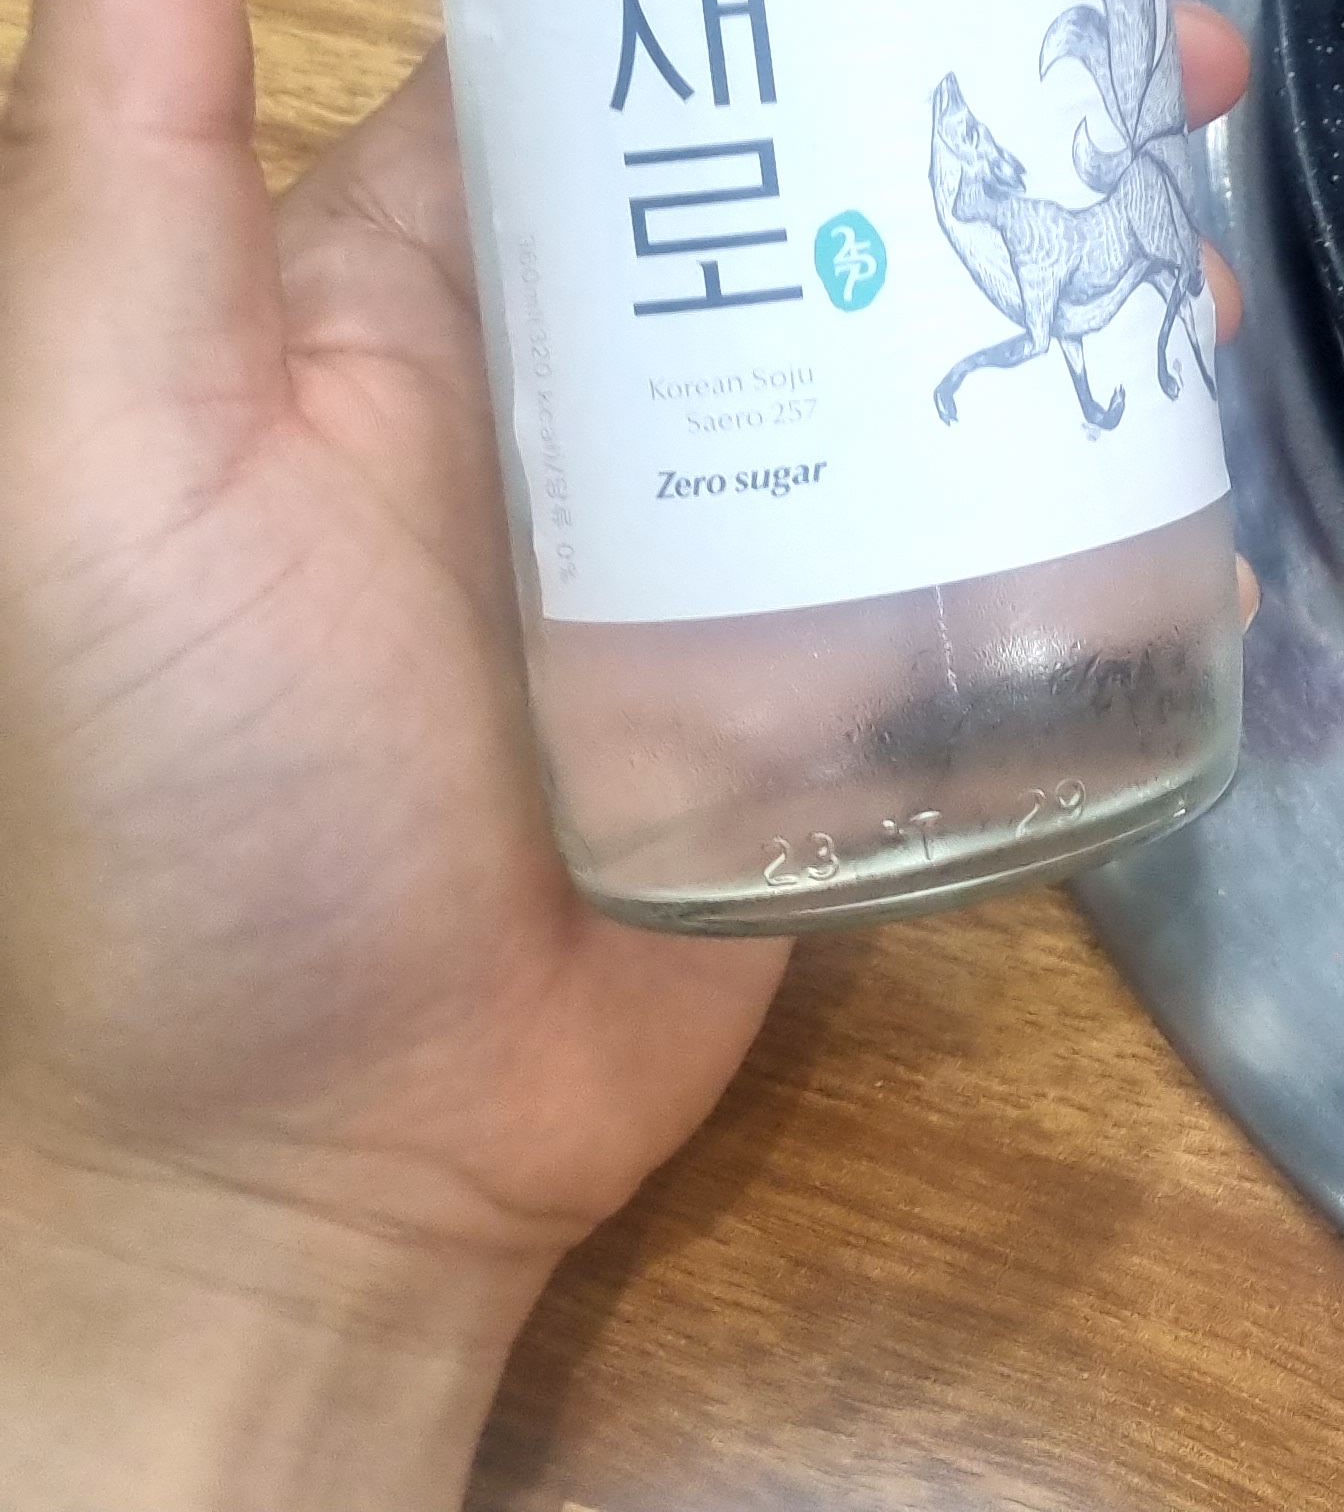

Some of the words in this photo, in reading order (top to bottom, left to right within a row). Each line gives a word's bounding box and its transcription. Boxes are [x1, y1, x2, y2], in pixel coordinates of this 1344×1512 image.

[648, 374, 744, 401] Korean
[752, 362, 813, 394] Soju
[686, 410, 763, 433] Saero
[773, 397, 817, 425] 257
[656, 471, 727, 499] Zero
[734, 460, 828, 498] sugar
